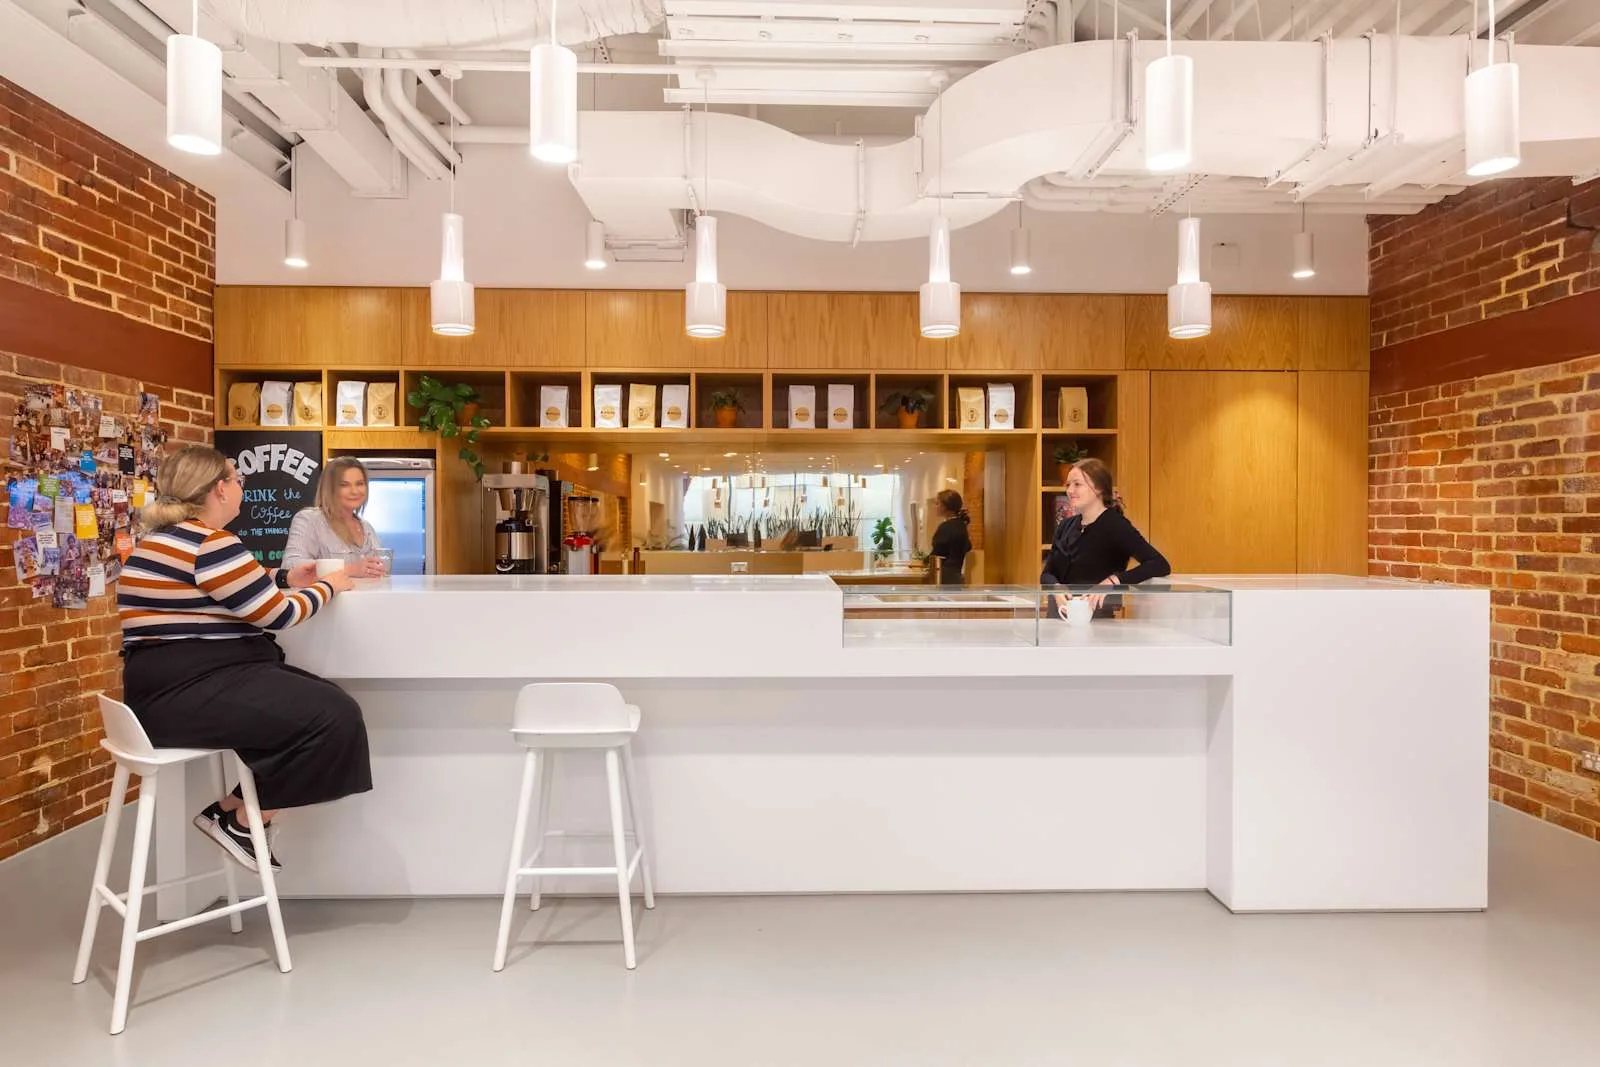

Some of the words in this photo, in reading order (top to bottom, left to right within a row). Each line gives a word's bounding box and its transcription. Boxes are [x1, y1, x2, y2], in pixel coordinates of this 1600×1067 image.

[243, 489, 277, 502] RINK
[284, 488, 301, 500] the
[251, 505, 292, 525] Coffee
[250, 527, 263, 536] THE
